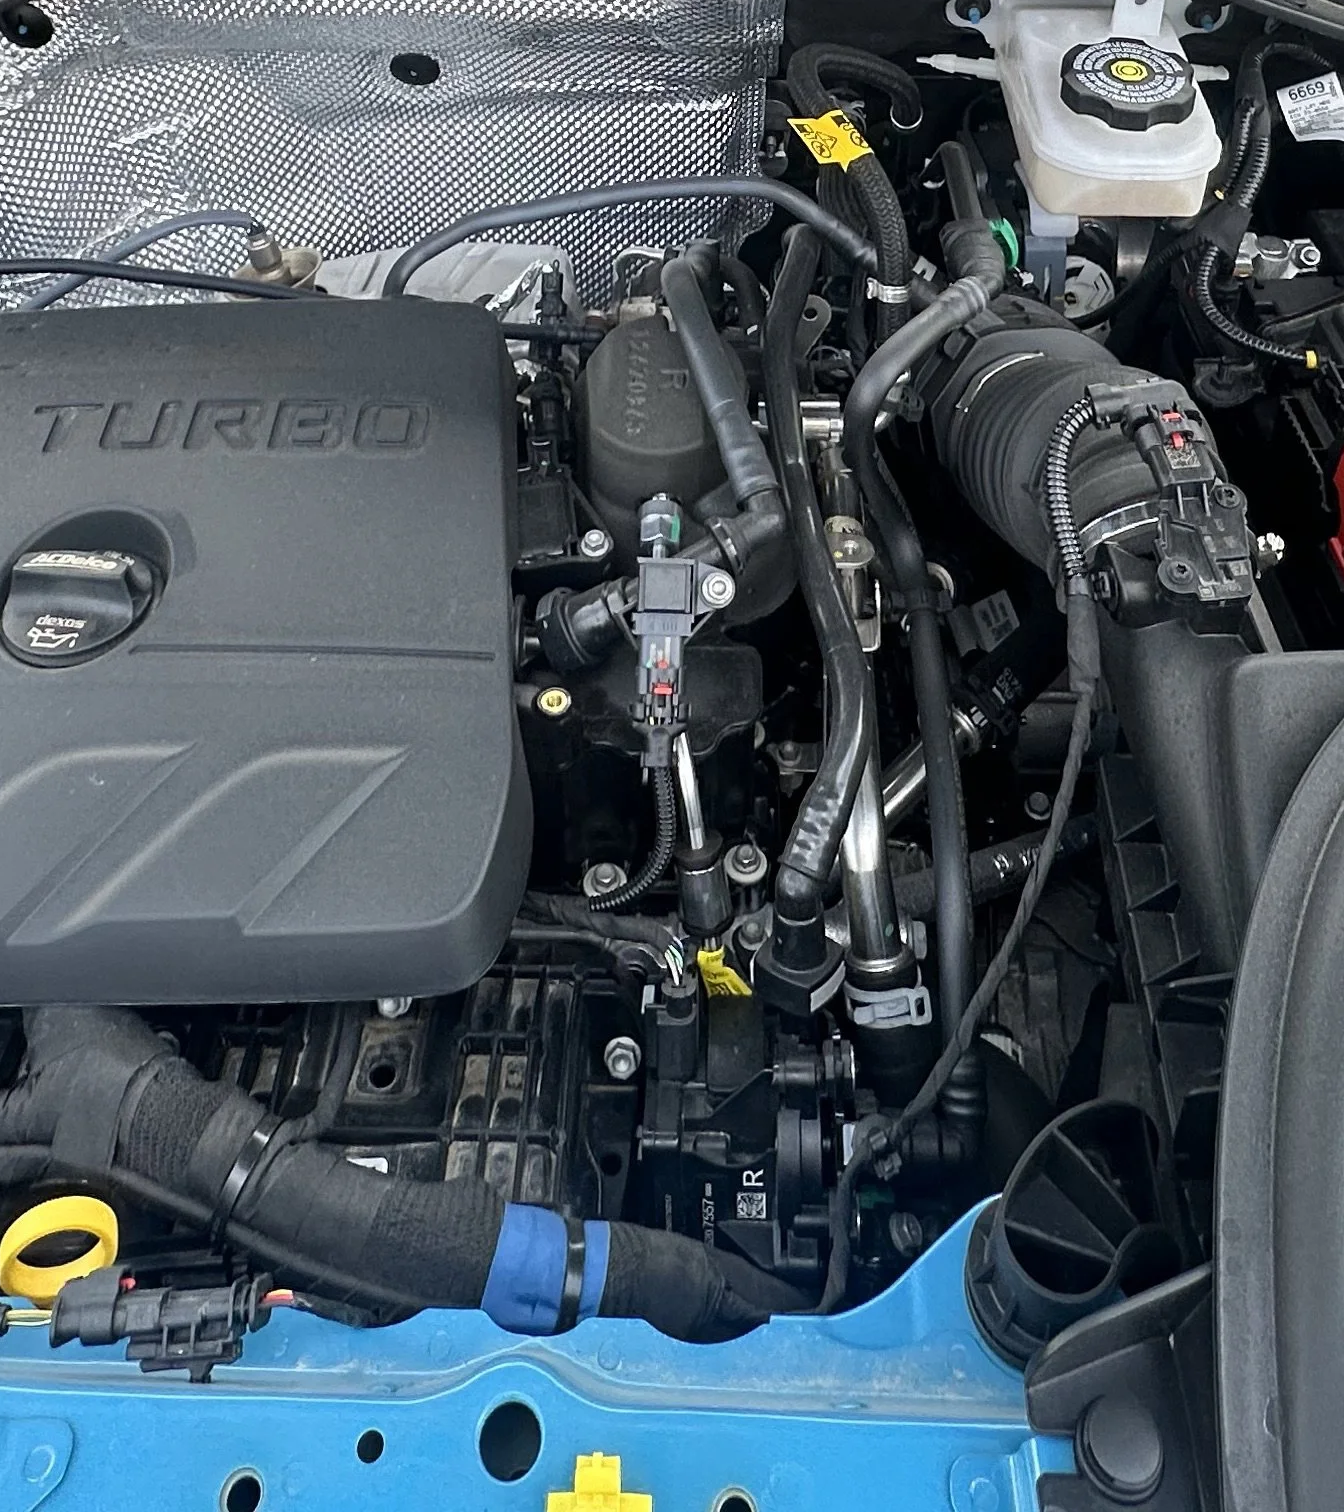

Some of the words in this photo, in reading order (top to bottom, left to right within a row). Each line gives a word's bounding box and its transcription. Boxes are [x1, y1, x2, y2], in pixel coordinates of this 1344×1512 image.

[1288, 80, 1325, 101] 6669
[34, 398, 431, 454] TURBO
[29, 552, 118, 570] ACDelco
[35, 614, 87, 630] dexos
[742, 1169, 765, 1187] R
